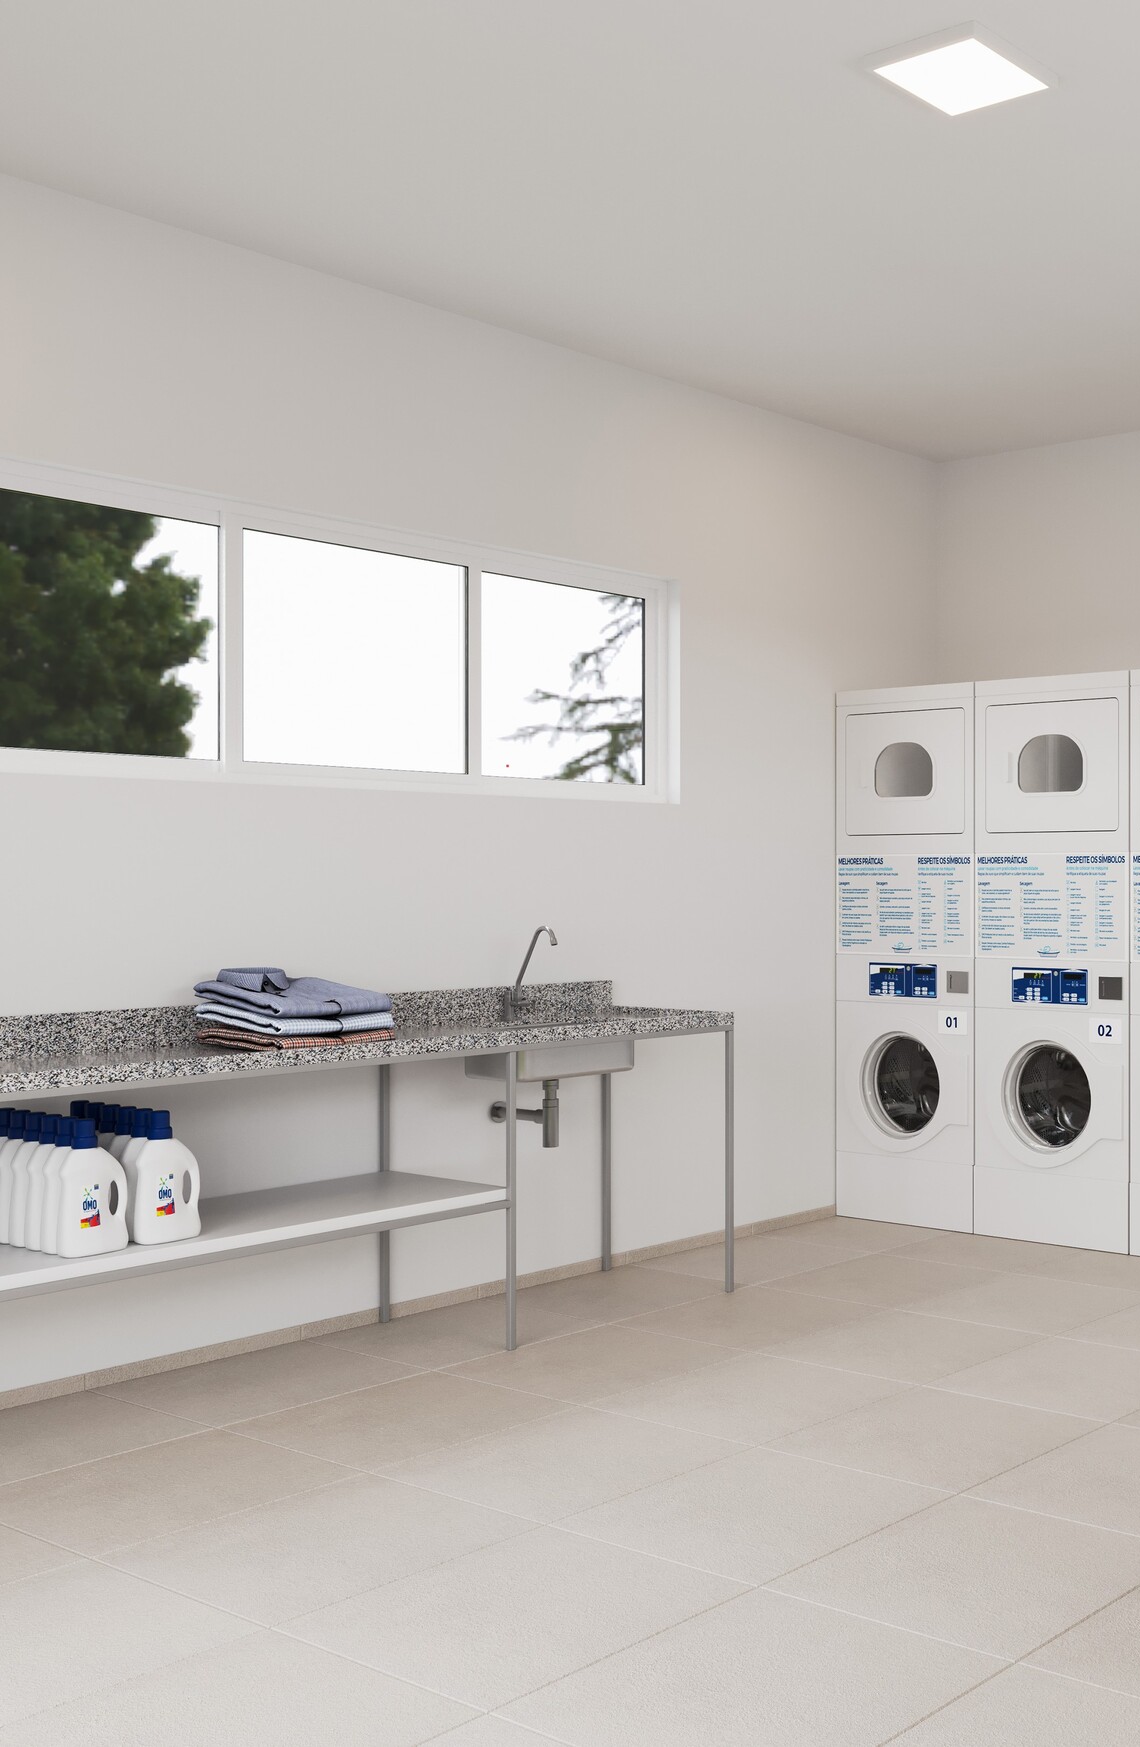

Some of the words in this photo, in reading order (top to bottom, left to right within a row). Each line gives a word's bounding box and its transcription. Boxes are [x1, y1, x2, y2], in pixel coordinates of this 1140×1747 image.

[862, 856, 884, 864] PRÁTICAS
[947, 856, 970, 864] SÍMBOLOS
[1004, 855, 1028, 864] PRÁTICAS
[1091, 856, 1099, 864] OS
[1099, 854, 1126, 863] SÍMBOLOS
[946, 1016, 958, 1028] 01
[1098, 1024, 1112, 1036] 02
[158, 1188, 172, 1200] OMO
[82, 1200, 97, 1210] OMO
